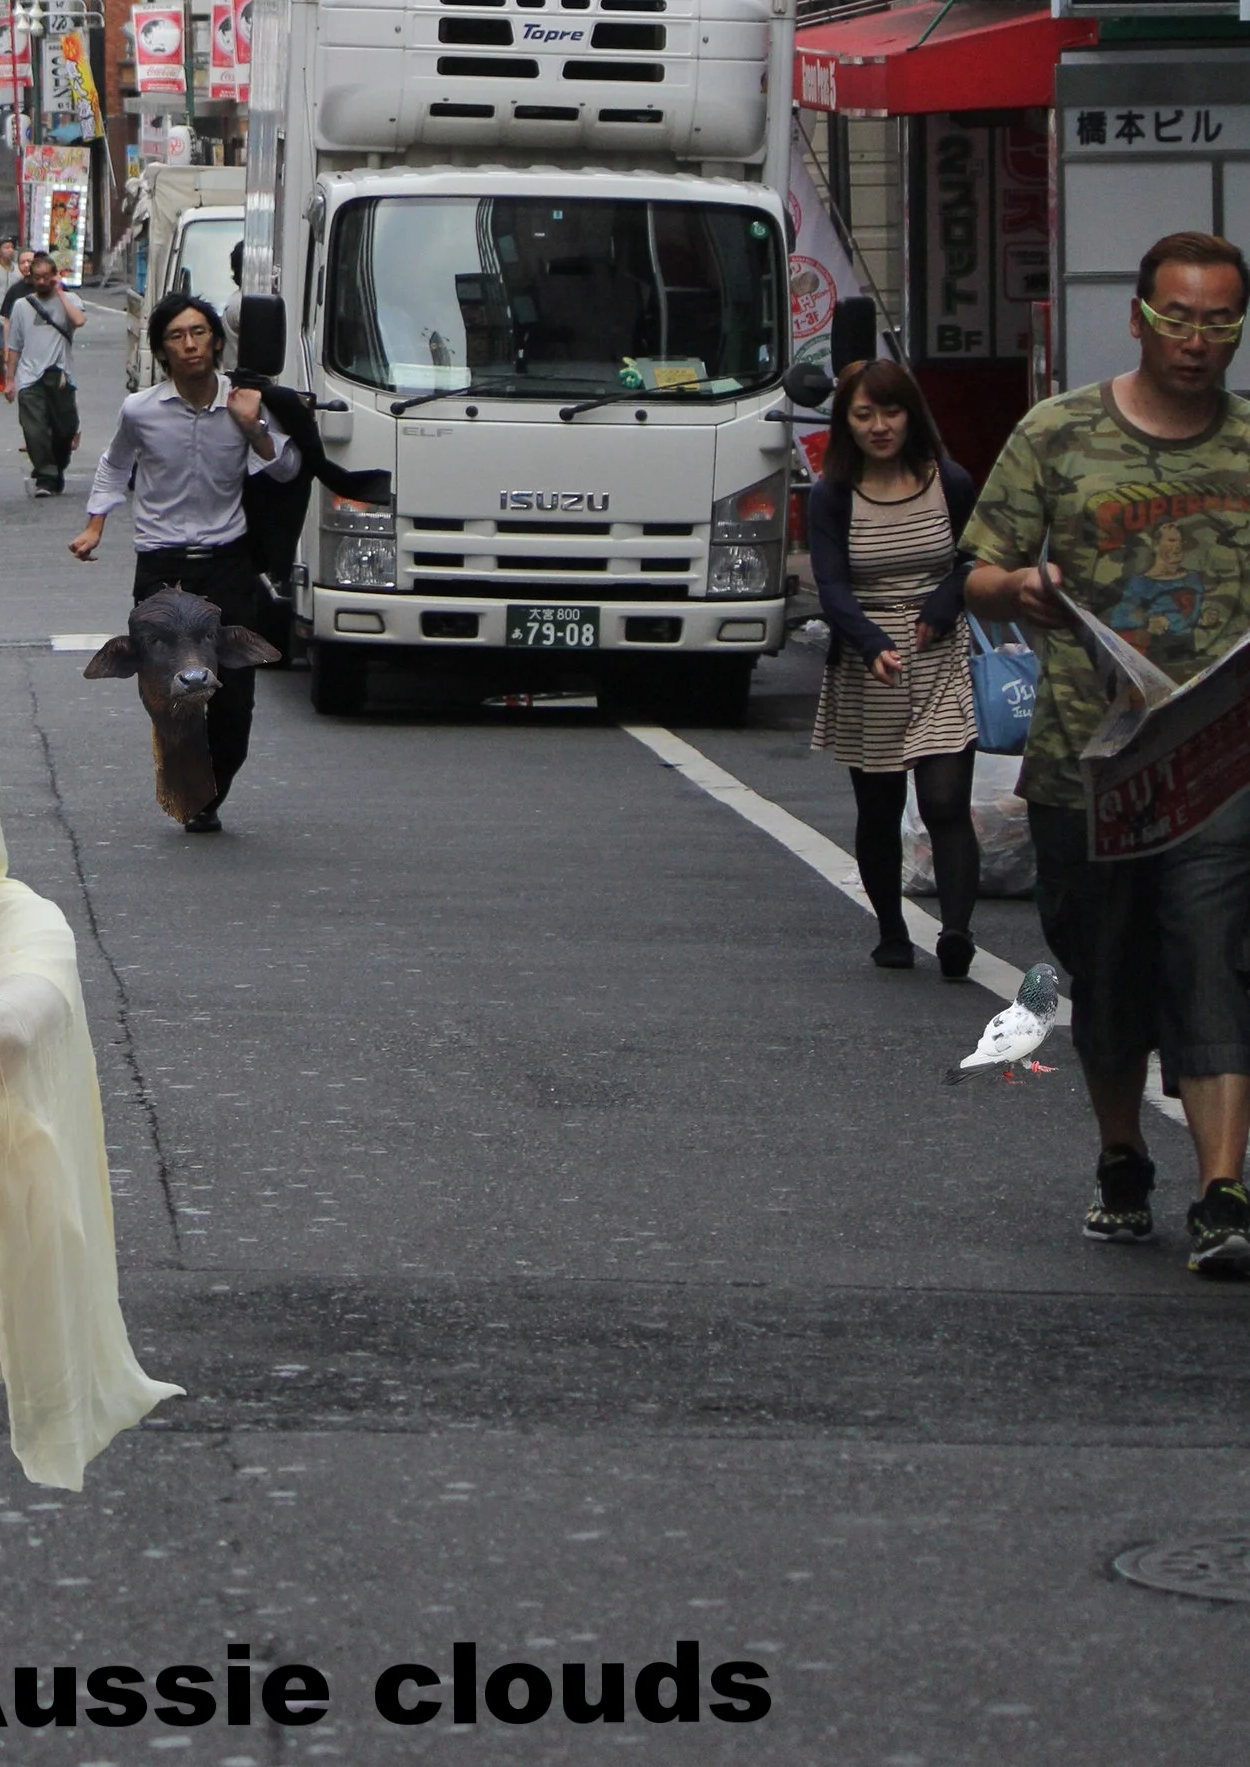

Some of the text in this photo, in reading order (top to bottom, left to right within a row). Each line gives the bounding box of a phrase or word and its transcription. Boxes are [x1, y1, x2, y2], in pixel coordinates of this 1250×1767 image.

[523, 22, 585, 43] Topre
[1076, 110, 1223, 146] 橋本ビル
[402, 426, 454, 438] ELF
[500, 490, 610, 512] ISUZU
[529, 608, 581, 621] 大宮 800
[511, 622, 595, 646] あ 79-08
